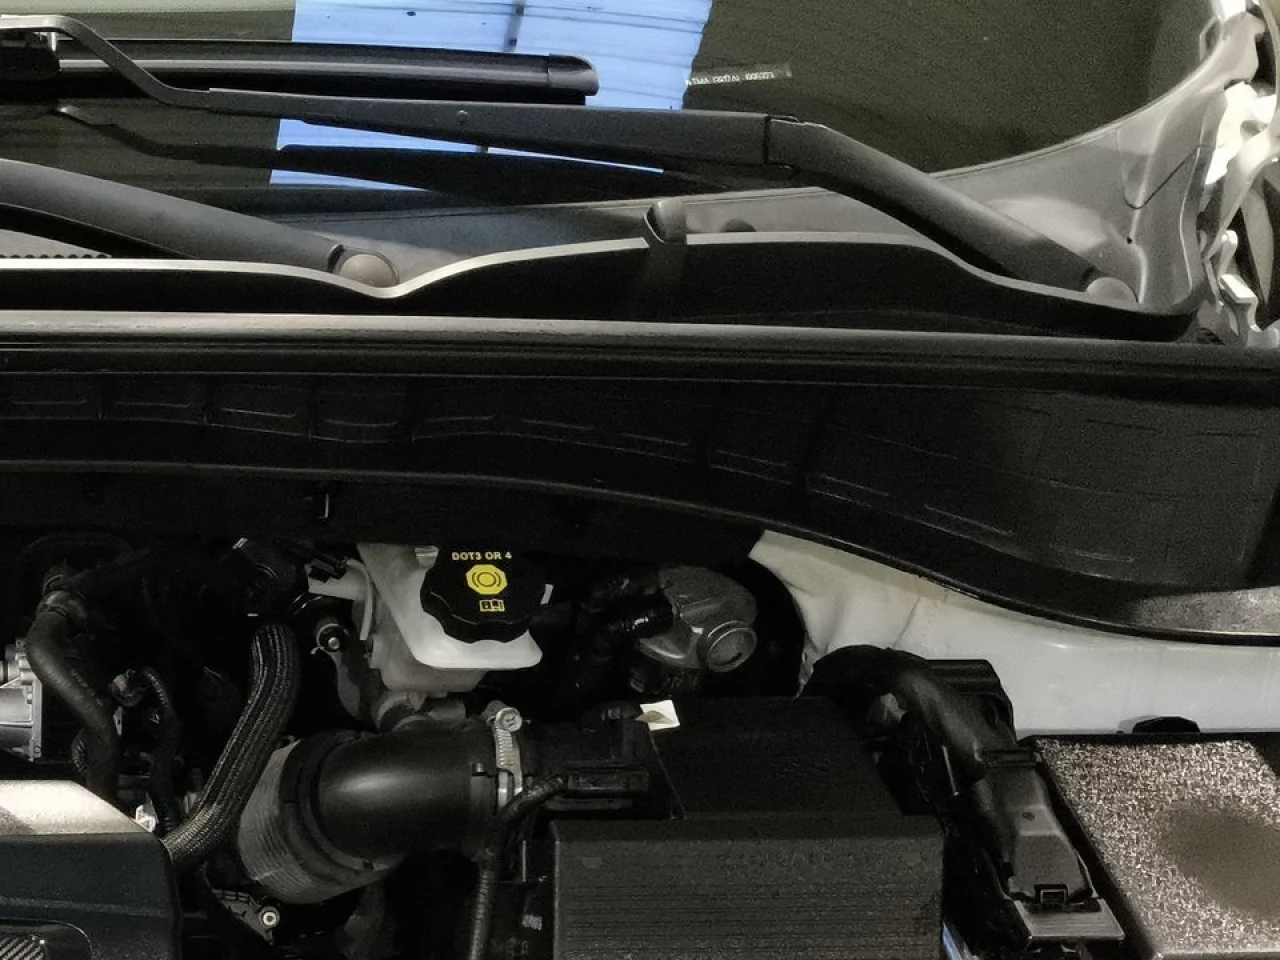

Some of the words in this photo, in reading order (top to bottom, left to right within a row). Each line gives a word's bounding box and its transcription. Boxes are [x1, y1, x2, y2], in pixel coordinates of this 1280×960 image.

[451, 551, 482, 561] DOT3
[484, 551, 502, 561] OR
[504, 550, 513, 560] 4
